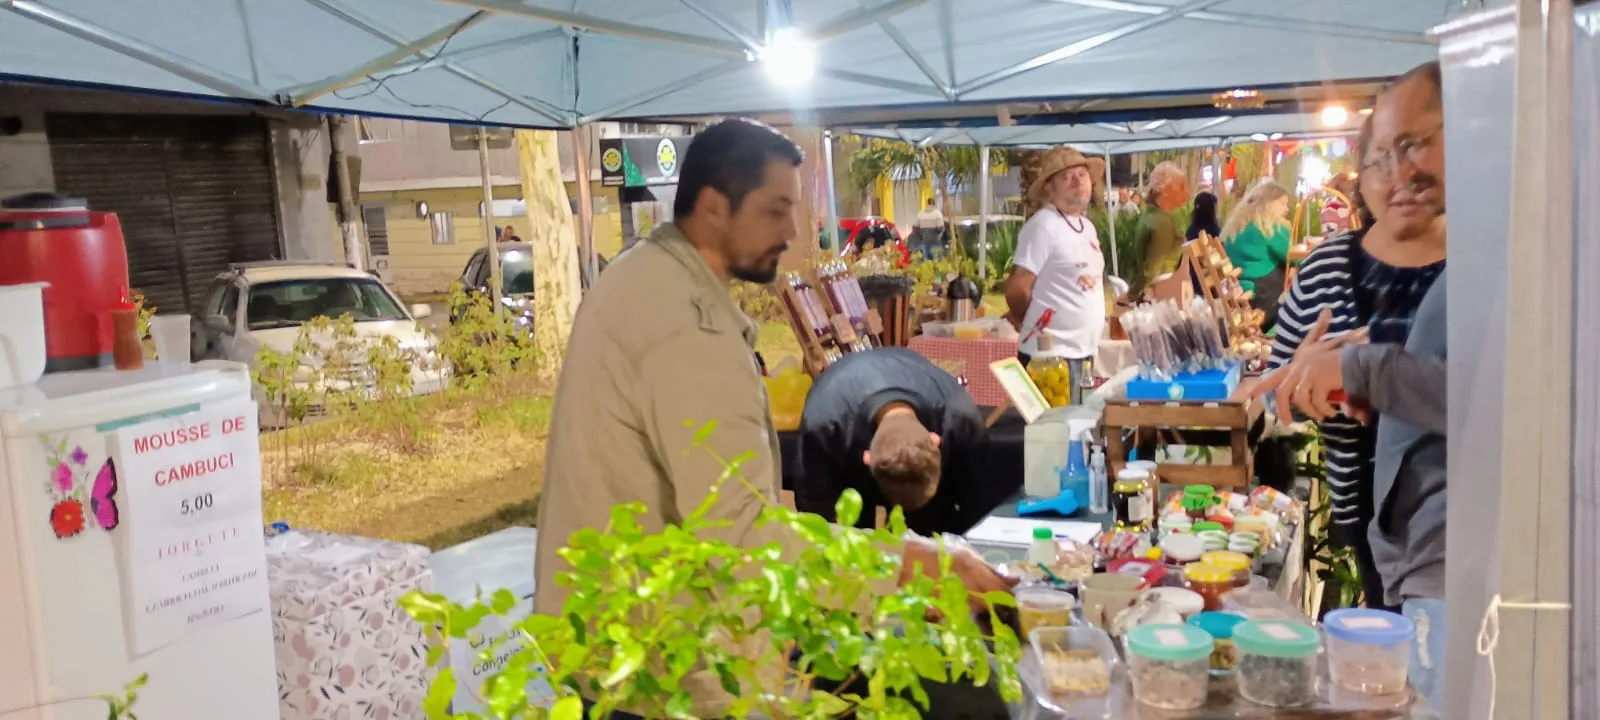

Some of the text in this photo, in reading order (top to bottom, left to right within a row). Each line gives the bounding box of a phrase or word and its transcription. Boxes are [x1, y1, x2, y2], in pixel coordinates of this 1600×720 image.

[133, 415, 246, 454] MOUSSE DE
[154, 452, 234, 487] CAMBUCI
[181, 492, 214, 515] 5,00
